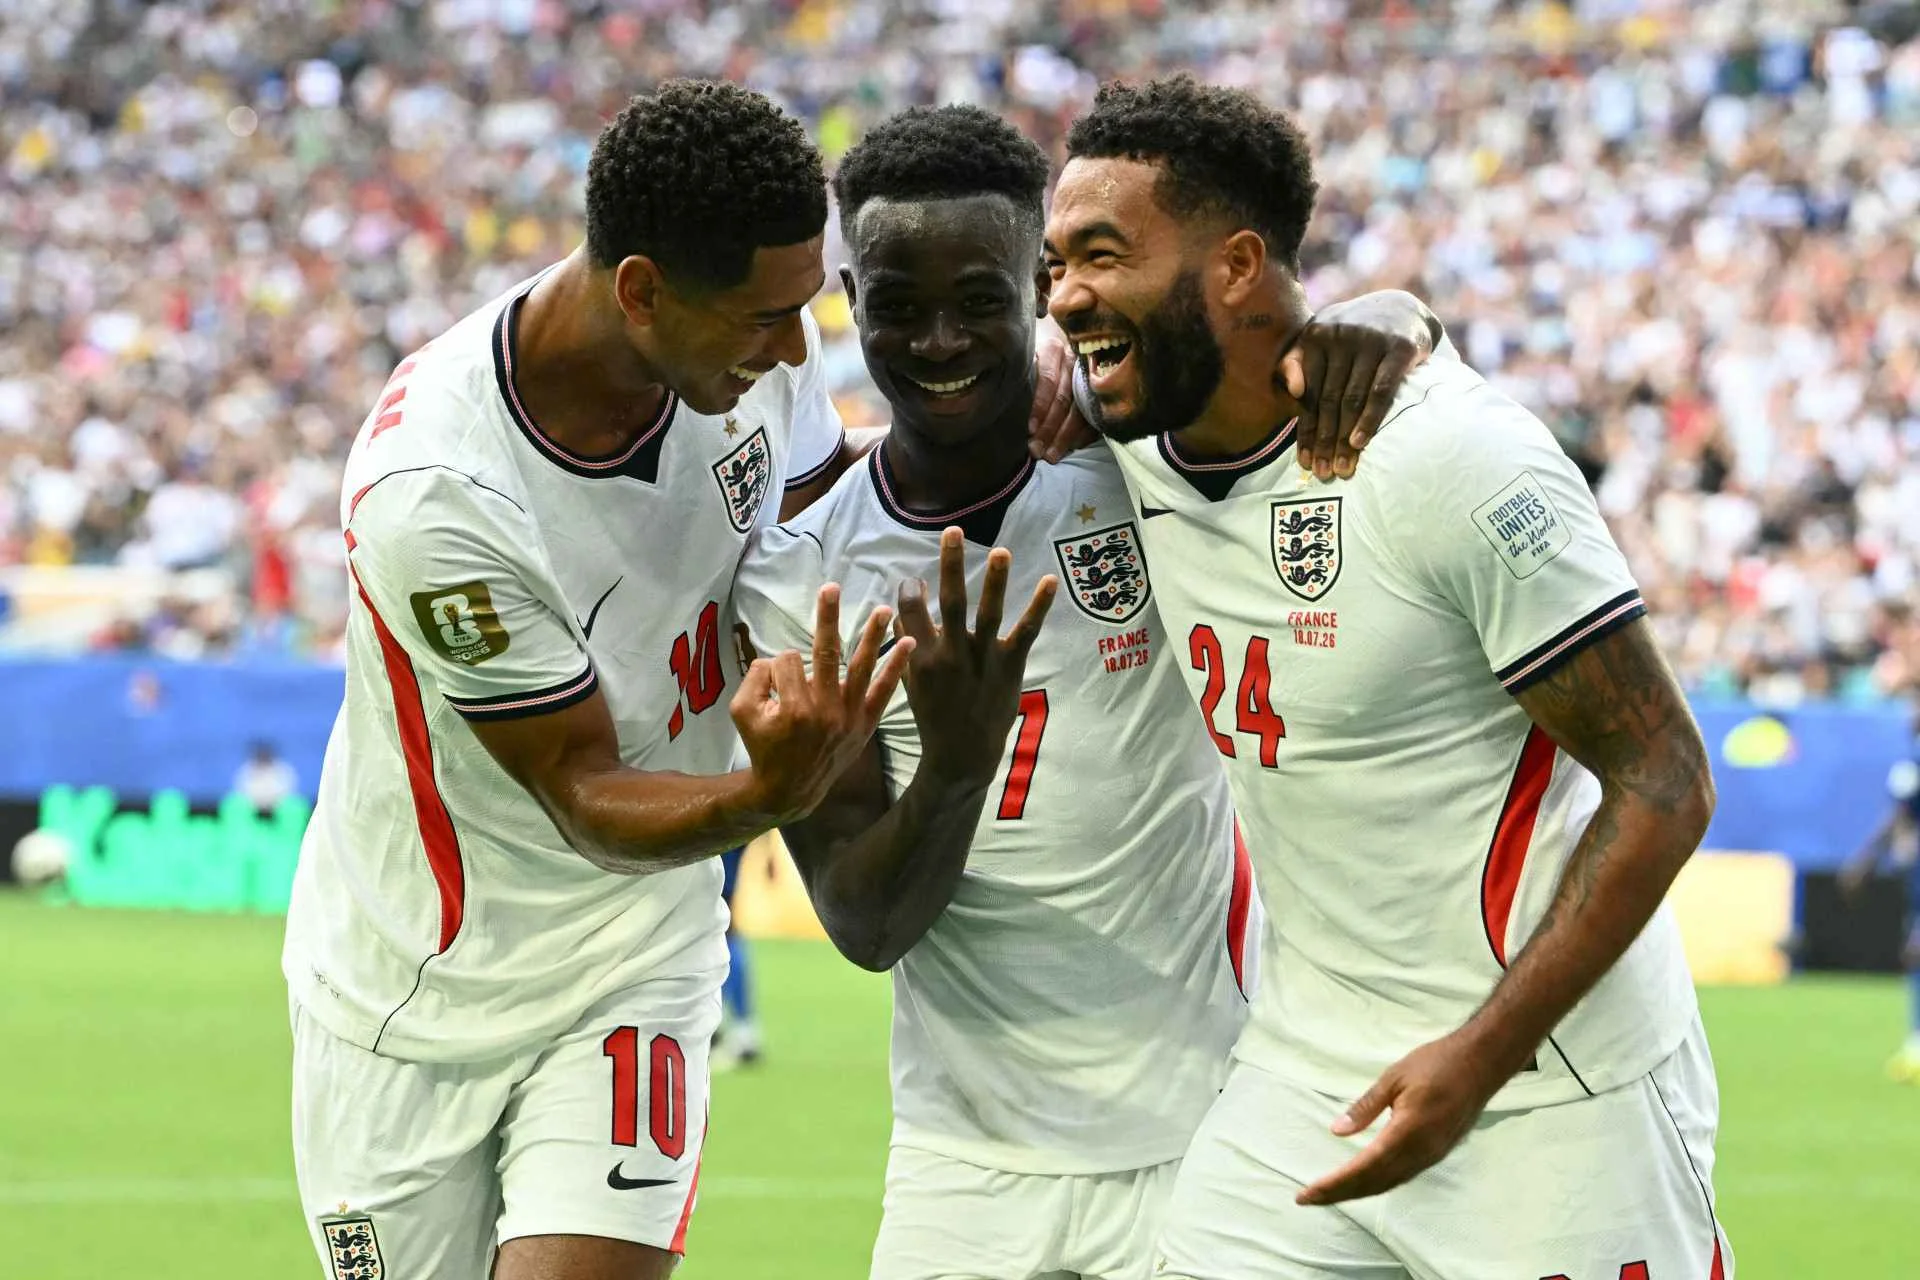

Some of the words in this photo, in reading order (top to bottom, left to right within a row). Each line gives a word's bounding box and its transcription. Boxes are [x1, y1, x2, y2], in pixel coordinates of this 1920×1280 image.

[1487, 487, 1536, 527] FOOTBALL
[1496, 498, 1546, 542] UNITES
[1507, 541, 1528, 558] the
[1526, 512, 1558, 545] World
[1531, 540, 1551, 558] FIFA
[1287, 611, 1337, 628] FRANCE
[1294, 629, 1335, 648] 18.07.26
[1098, 628, 1149, 655] FRANCE
[1104, 648, 1149, 673] 18.07.26
[667, 600, 726, 744] 10
[1188, 623, 1286, 769] 24
[996, 688, 1050, 820] 7
[602, 1025, 686, 1162] 10
